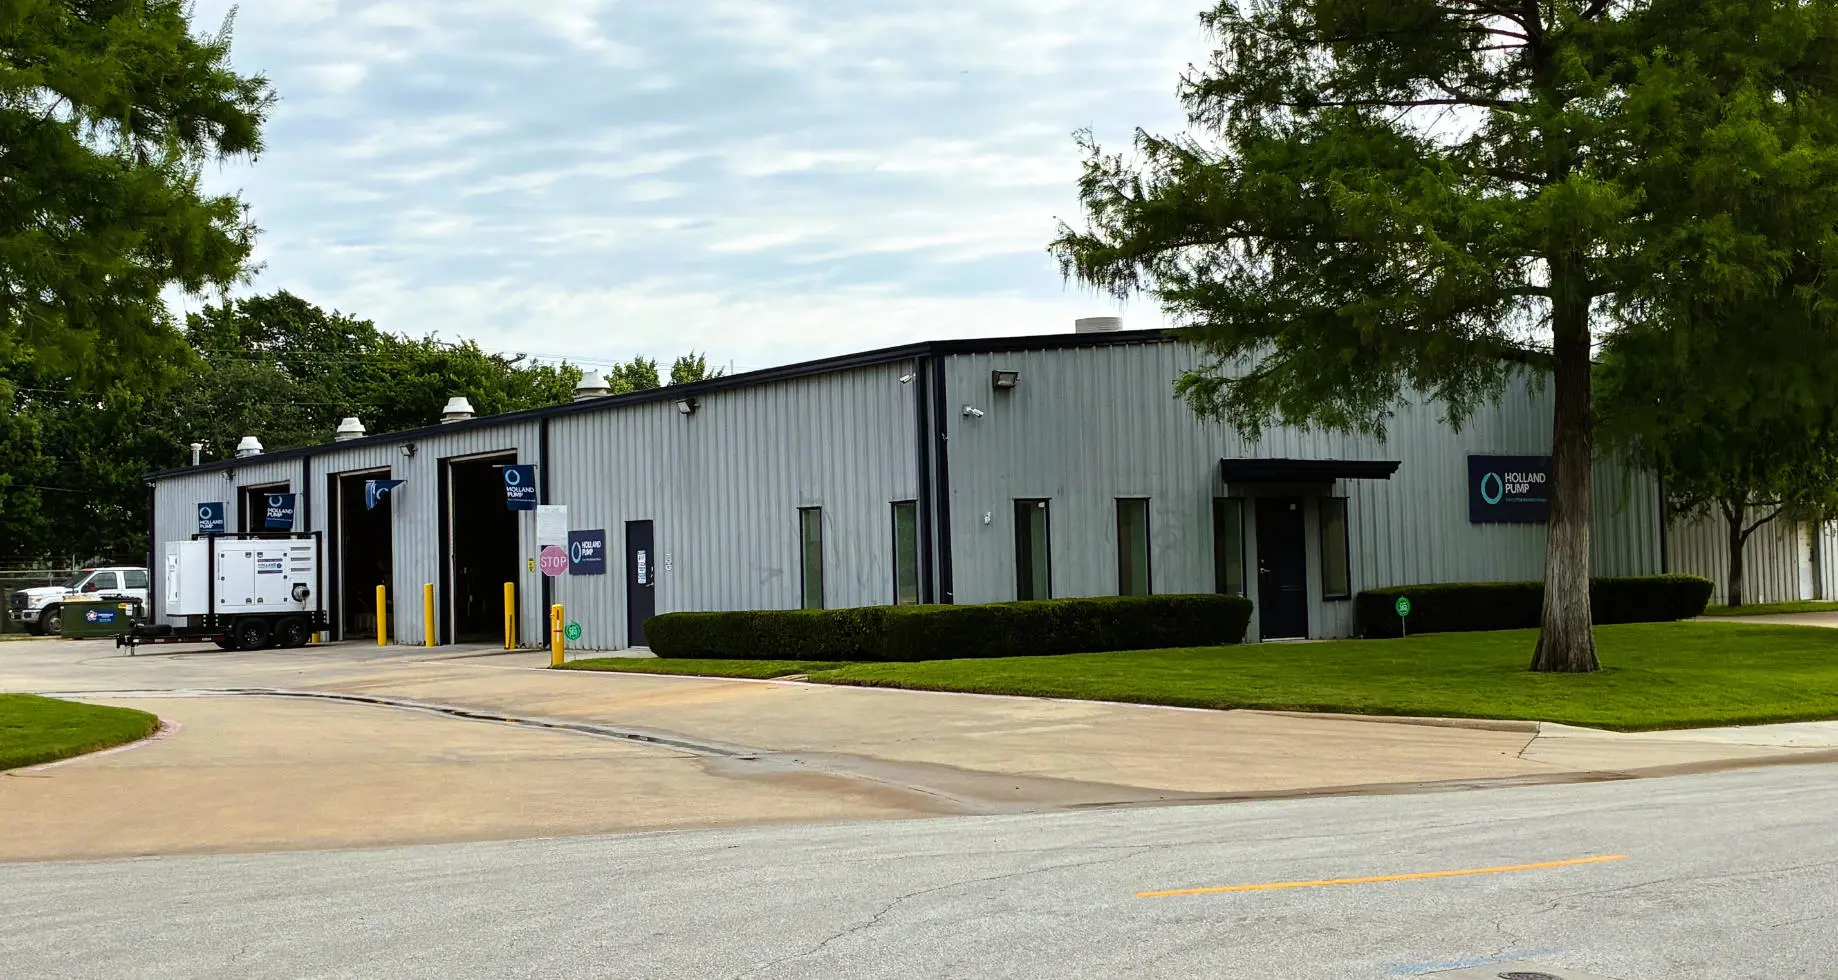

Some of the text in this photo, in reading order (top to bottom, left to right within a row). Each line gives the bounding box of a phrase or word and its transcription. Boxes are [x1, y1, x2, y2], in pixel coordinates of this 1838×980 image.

[1504, 472, 1546, 483] HOLLAND
[1505, 483, 1530, 494] PUMP
[581, 540, 602, 549] HOLLAND
[581, 548, 594, 556] PUMP
[541, 556, 567, 568] STOP
